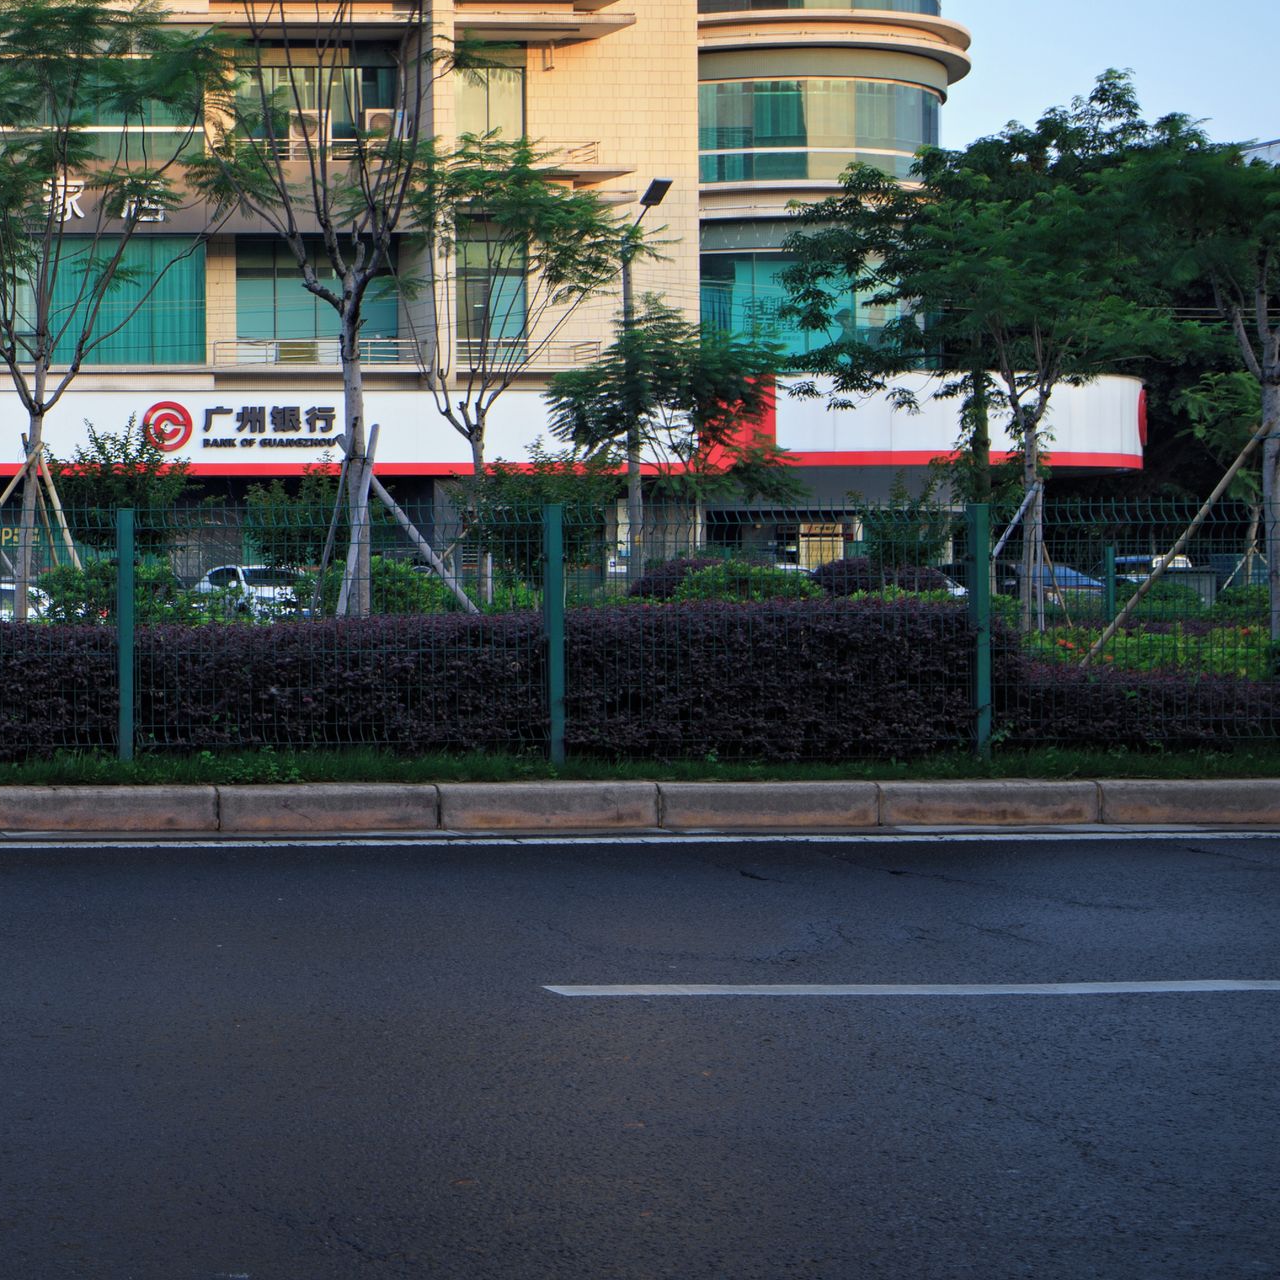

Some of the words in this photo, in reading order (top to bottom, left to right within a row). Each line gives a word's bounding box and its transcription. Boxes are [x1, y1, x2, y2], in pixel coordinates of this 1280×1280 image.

[203, 406, 336, 434] 广州银行
[203, 438, 237, 448] BANK
[240, 438, 257, 448] OF
[259, 438, 336, 448] GUANGZHOU
